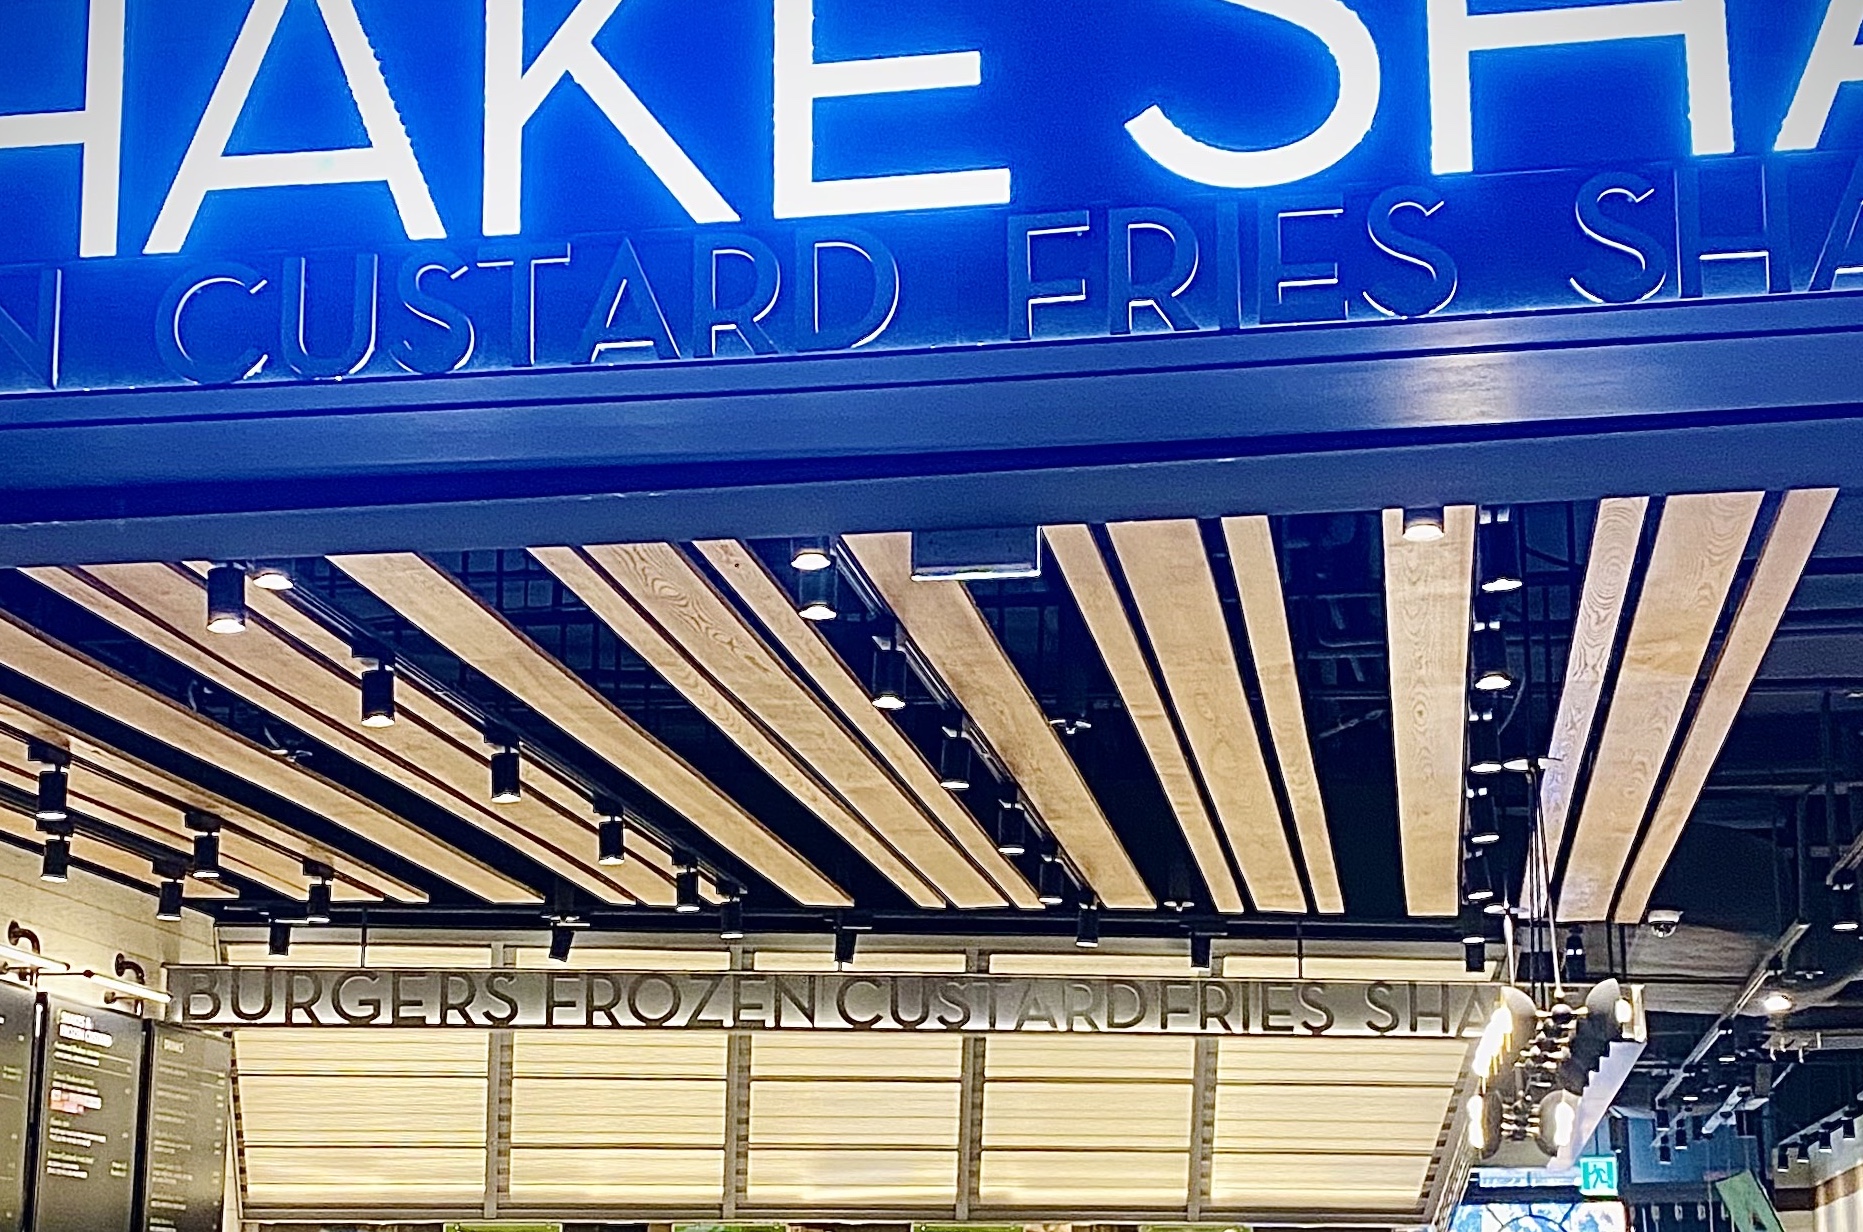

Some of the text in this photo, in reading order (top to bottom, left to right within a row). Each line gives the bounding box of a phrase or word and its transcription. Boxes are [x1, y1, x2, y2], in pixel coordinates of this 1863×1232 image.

[154, 229, 902, 386] CUSTARD
[1007, 184, 1460, 342] FRIES
[182, 967, 519, 1026] BURGERS
[545, 972, 816, 1029] FROZEN
[836, 976, 1149, 1032] CUSTARD
[1160, 980, 1335, 1036] FRIES
